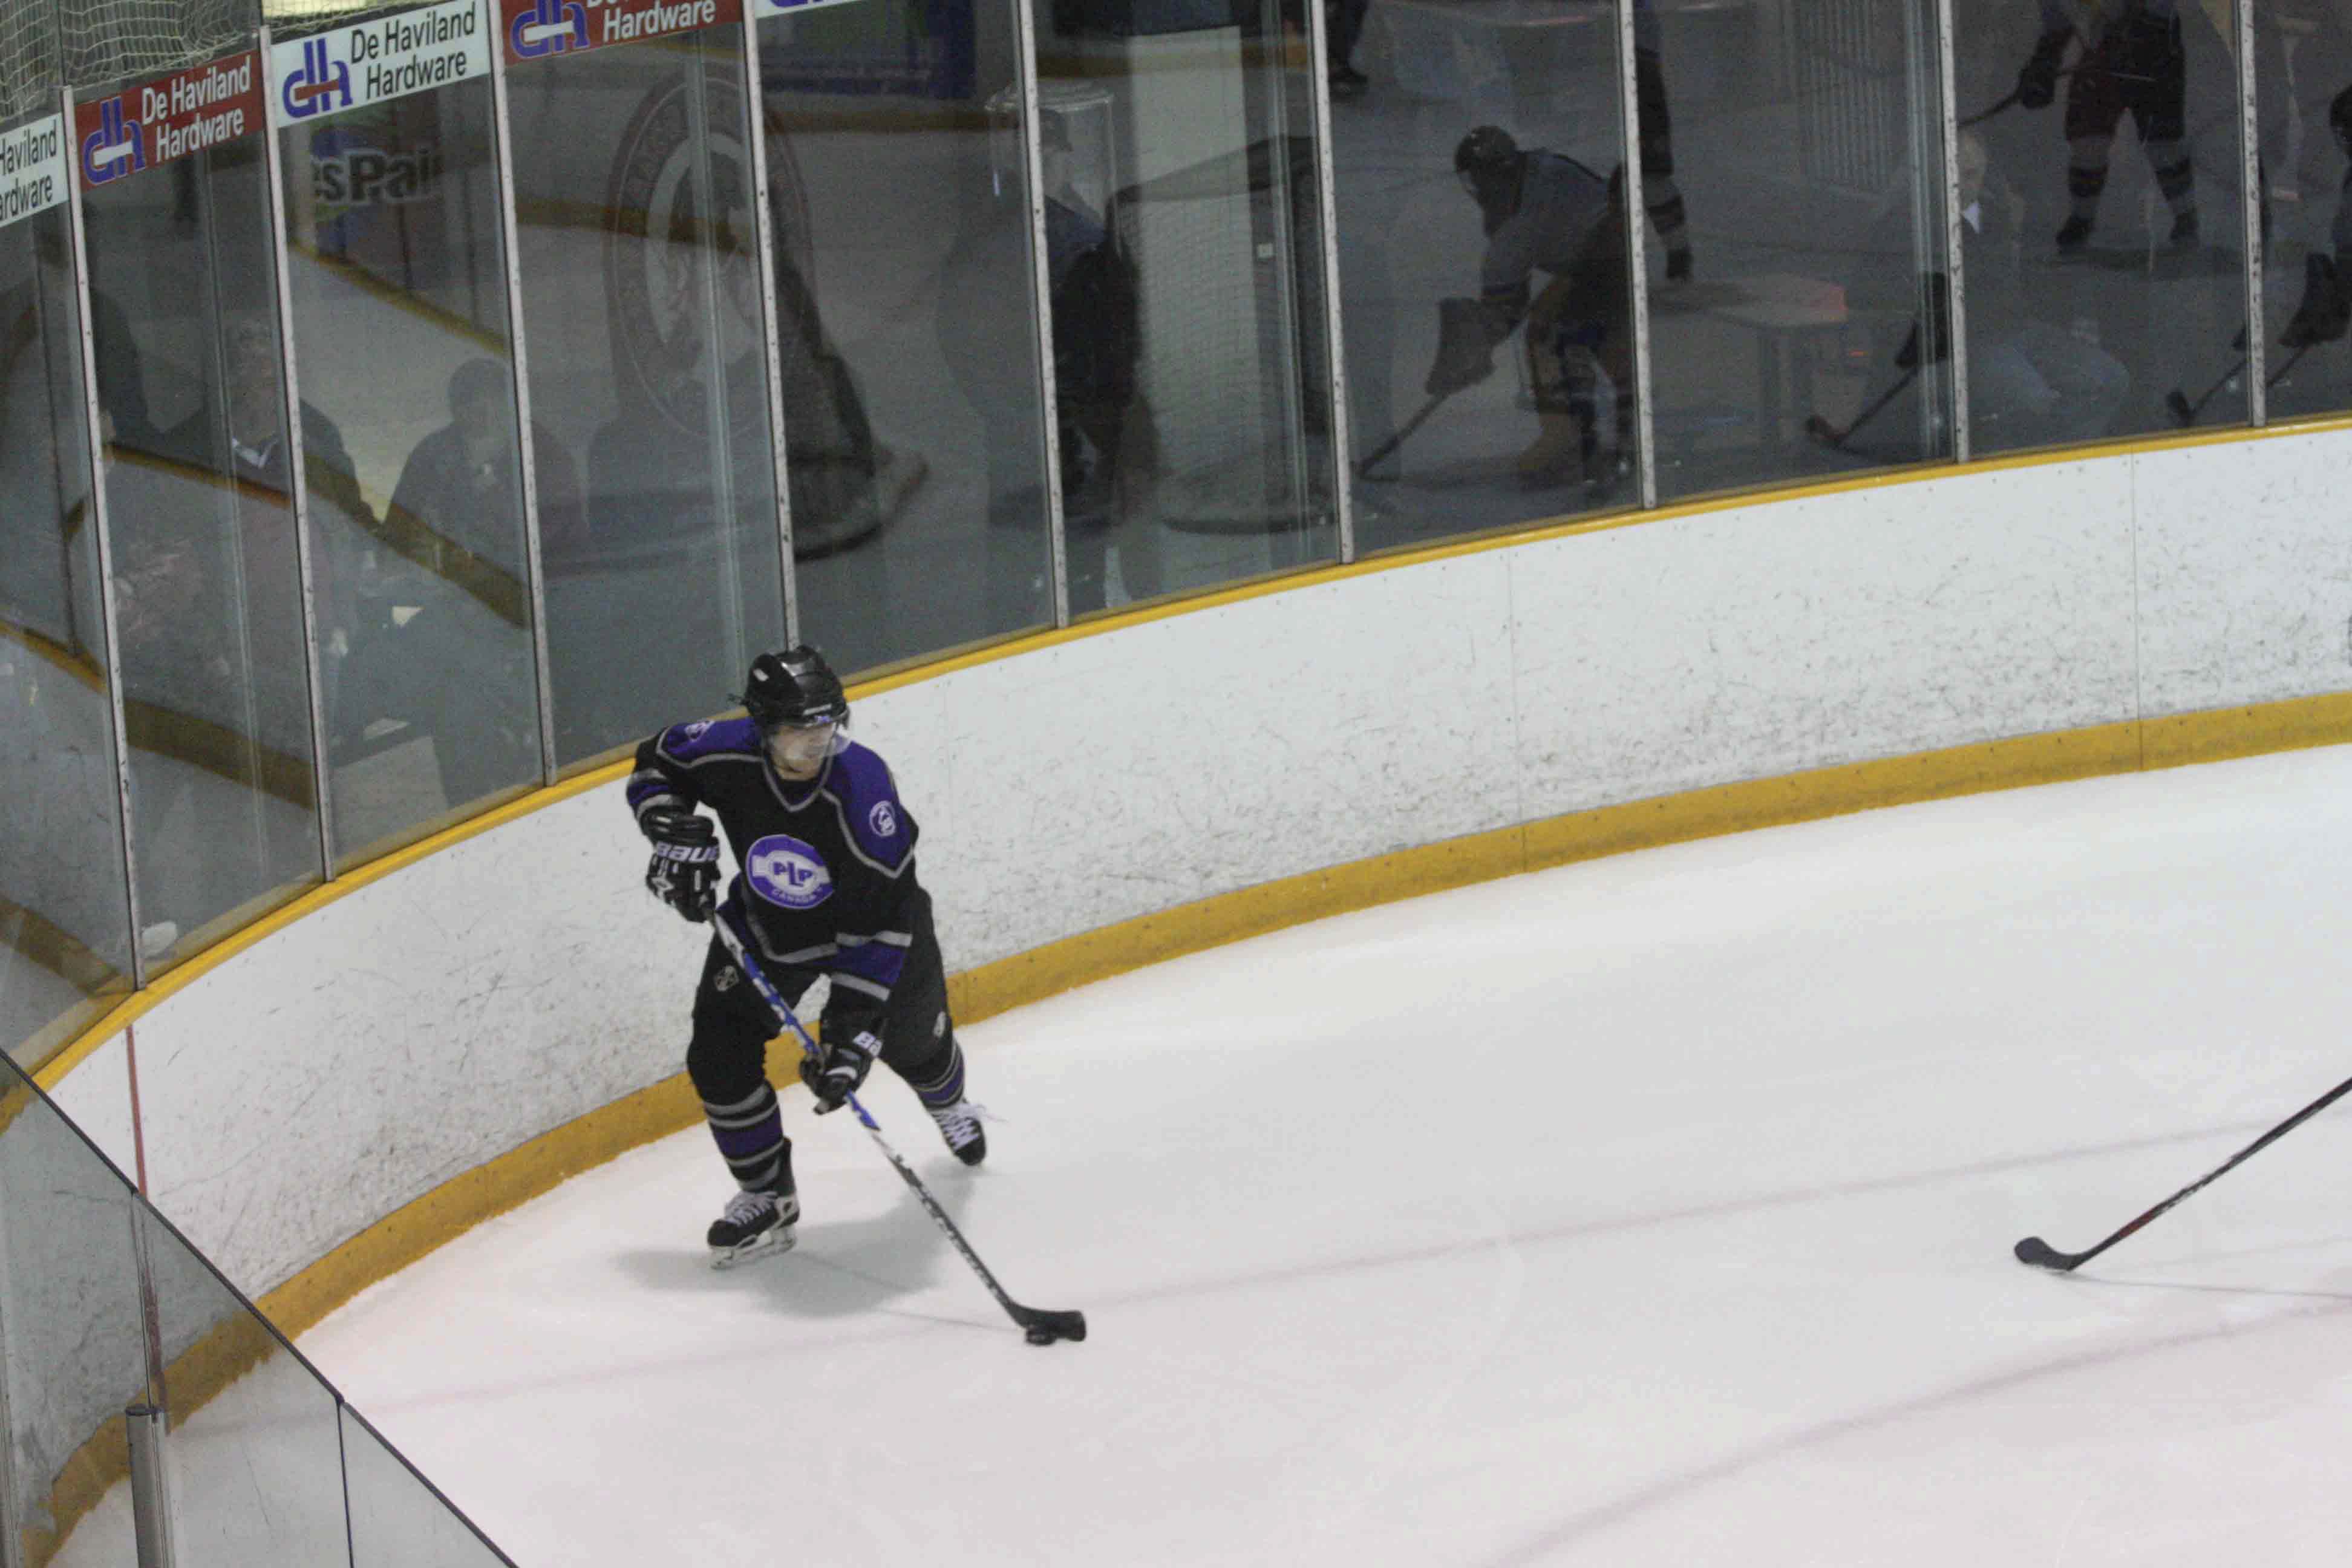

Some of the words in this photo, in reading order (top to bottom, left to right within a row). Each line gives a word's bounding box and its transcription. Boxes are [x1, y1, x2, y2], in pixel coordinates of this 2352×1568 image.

[351, 29, 379, 65] De
[385, 1, 475, 56] Haviland
[603, 0, 716, 42] Hardware
[142, 87, 168, 126] De
[171, 54, 251, 116] Haviland
[365, 50, 467, 100] Hardware
[155, 106, 244, 163] Hardware
